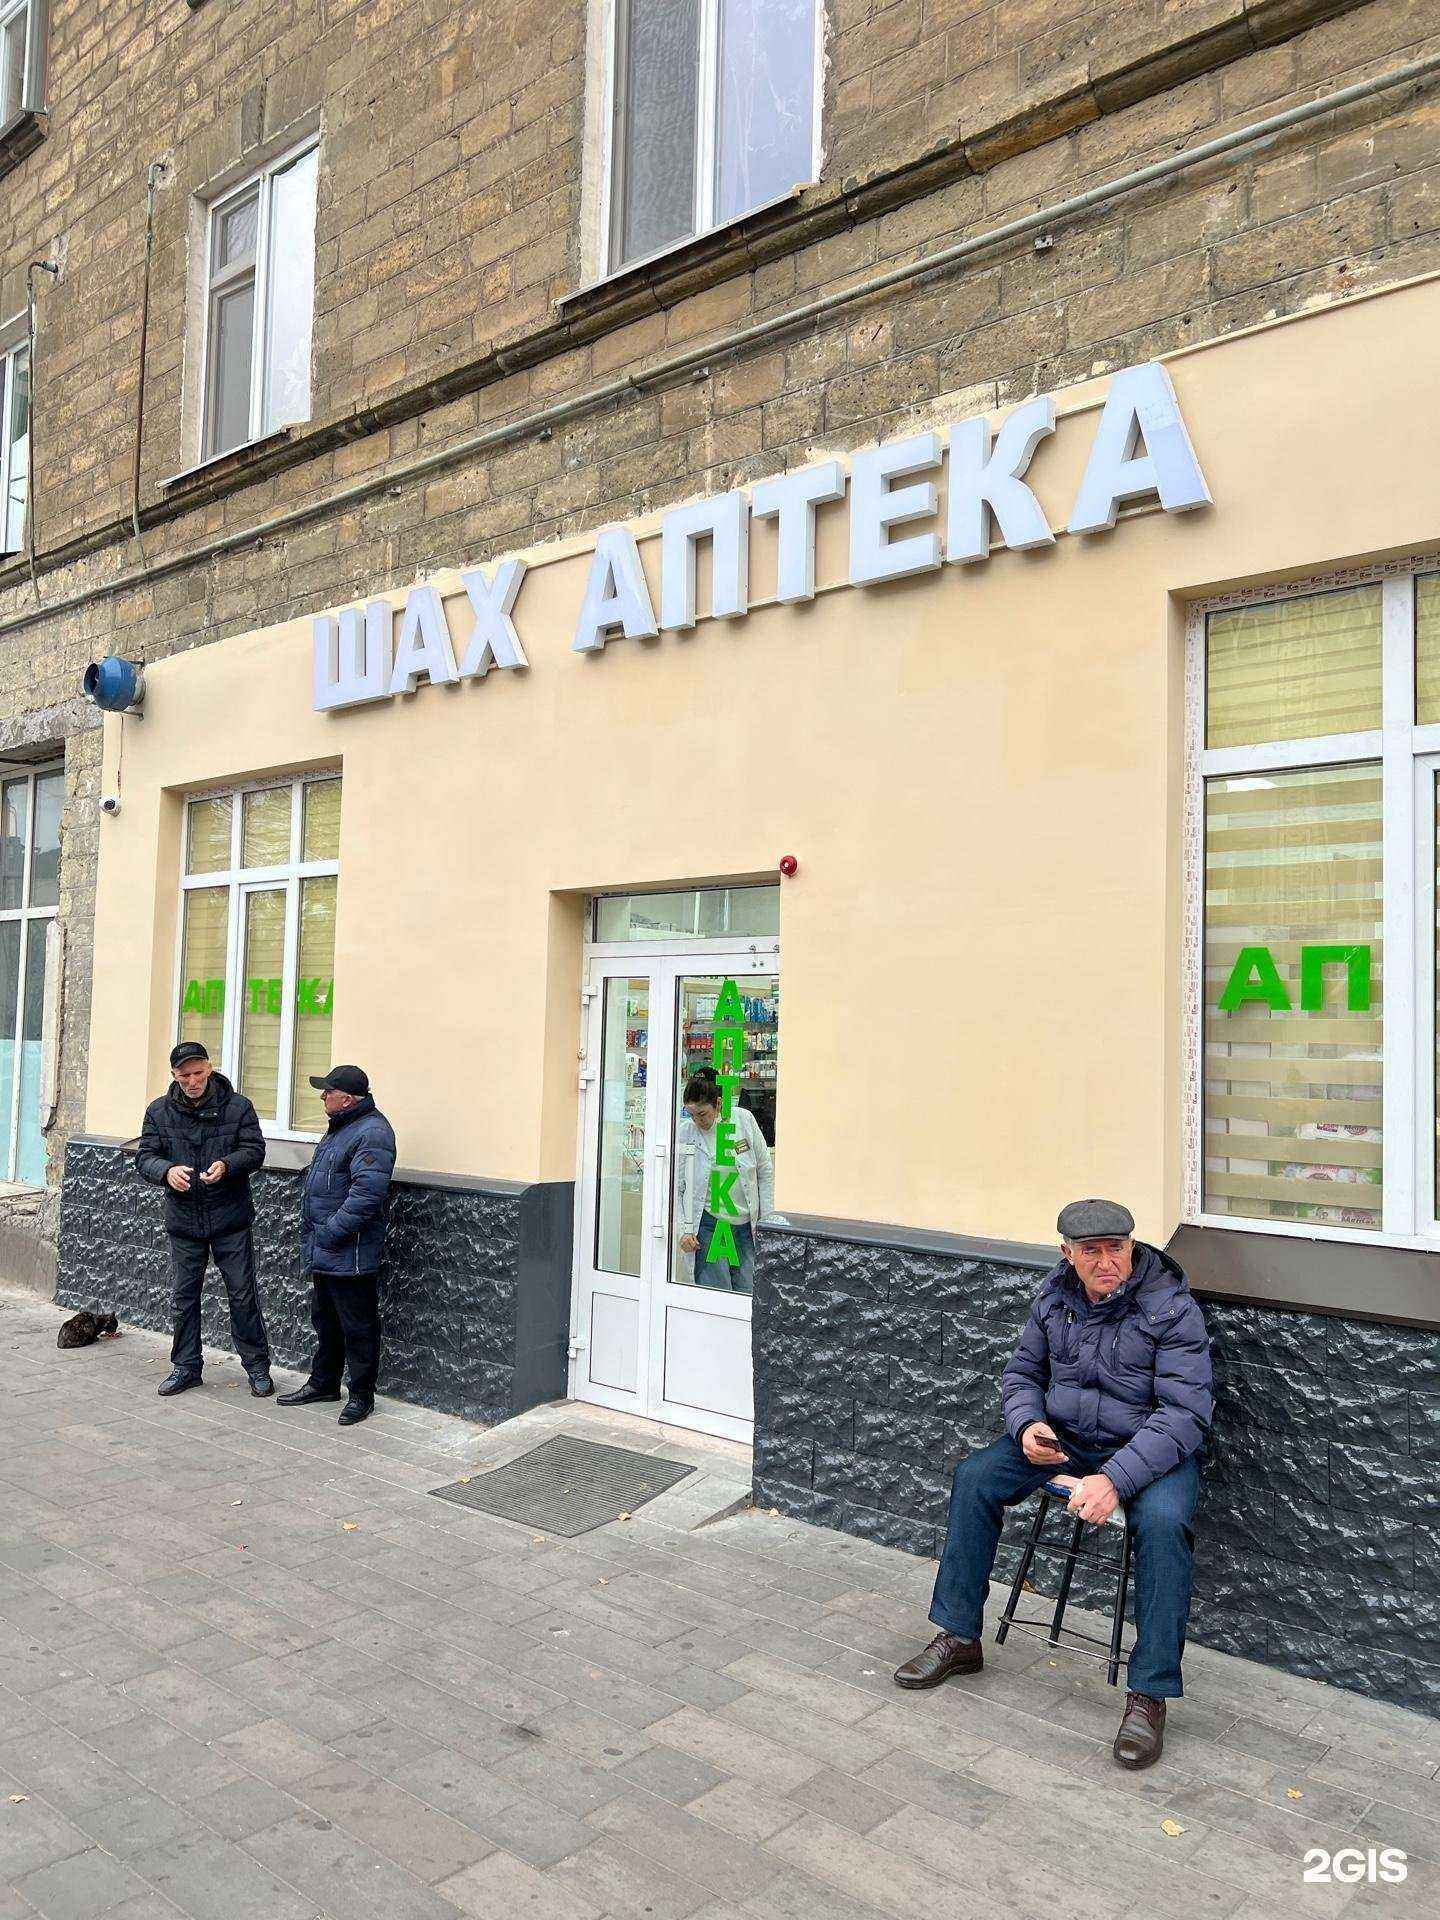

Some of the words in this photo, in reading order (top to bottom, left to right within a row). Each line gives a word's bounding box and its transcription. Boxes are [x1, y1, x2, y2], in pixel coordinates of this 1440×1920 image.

[312, 559, 529, 711] ШАХ
[571, 361, 1212, 654] АПТЕКА
[1218, 945, 1371, 1011] АП
[705, 979, 746, 1268] АПТЕКА
